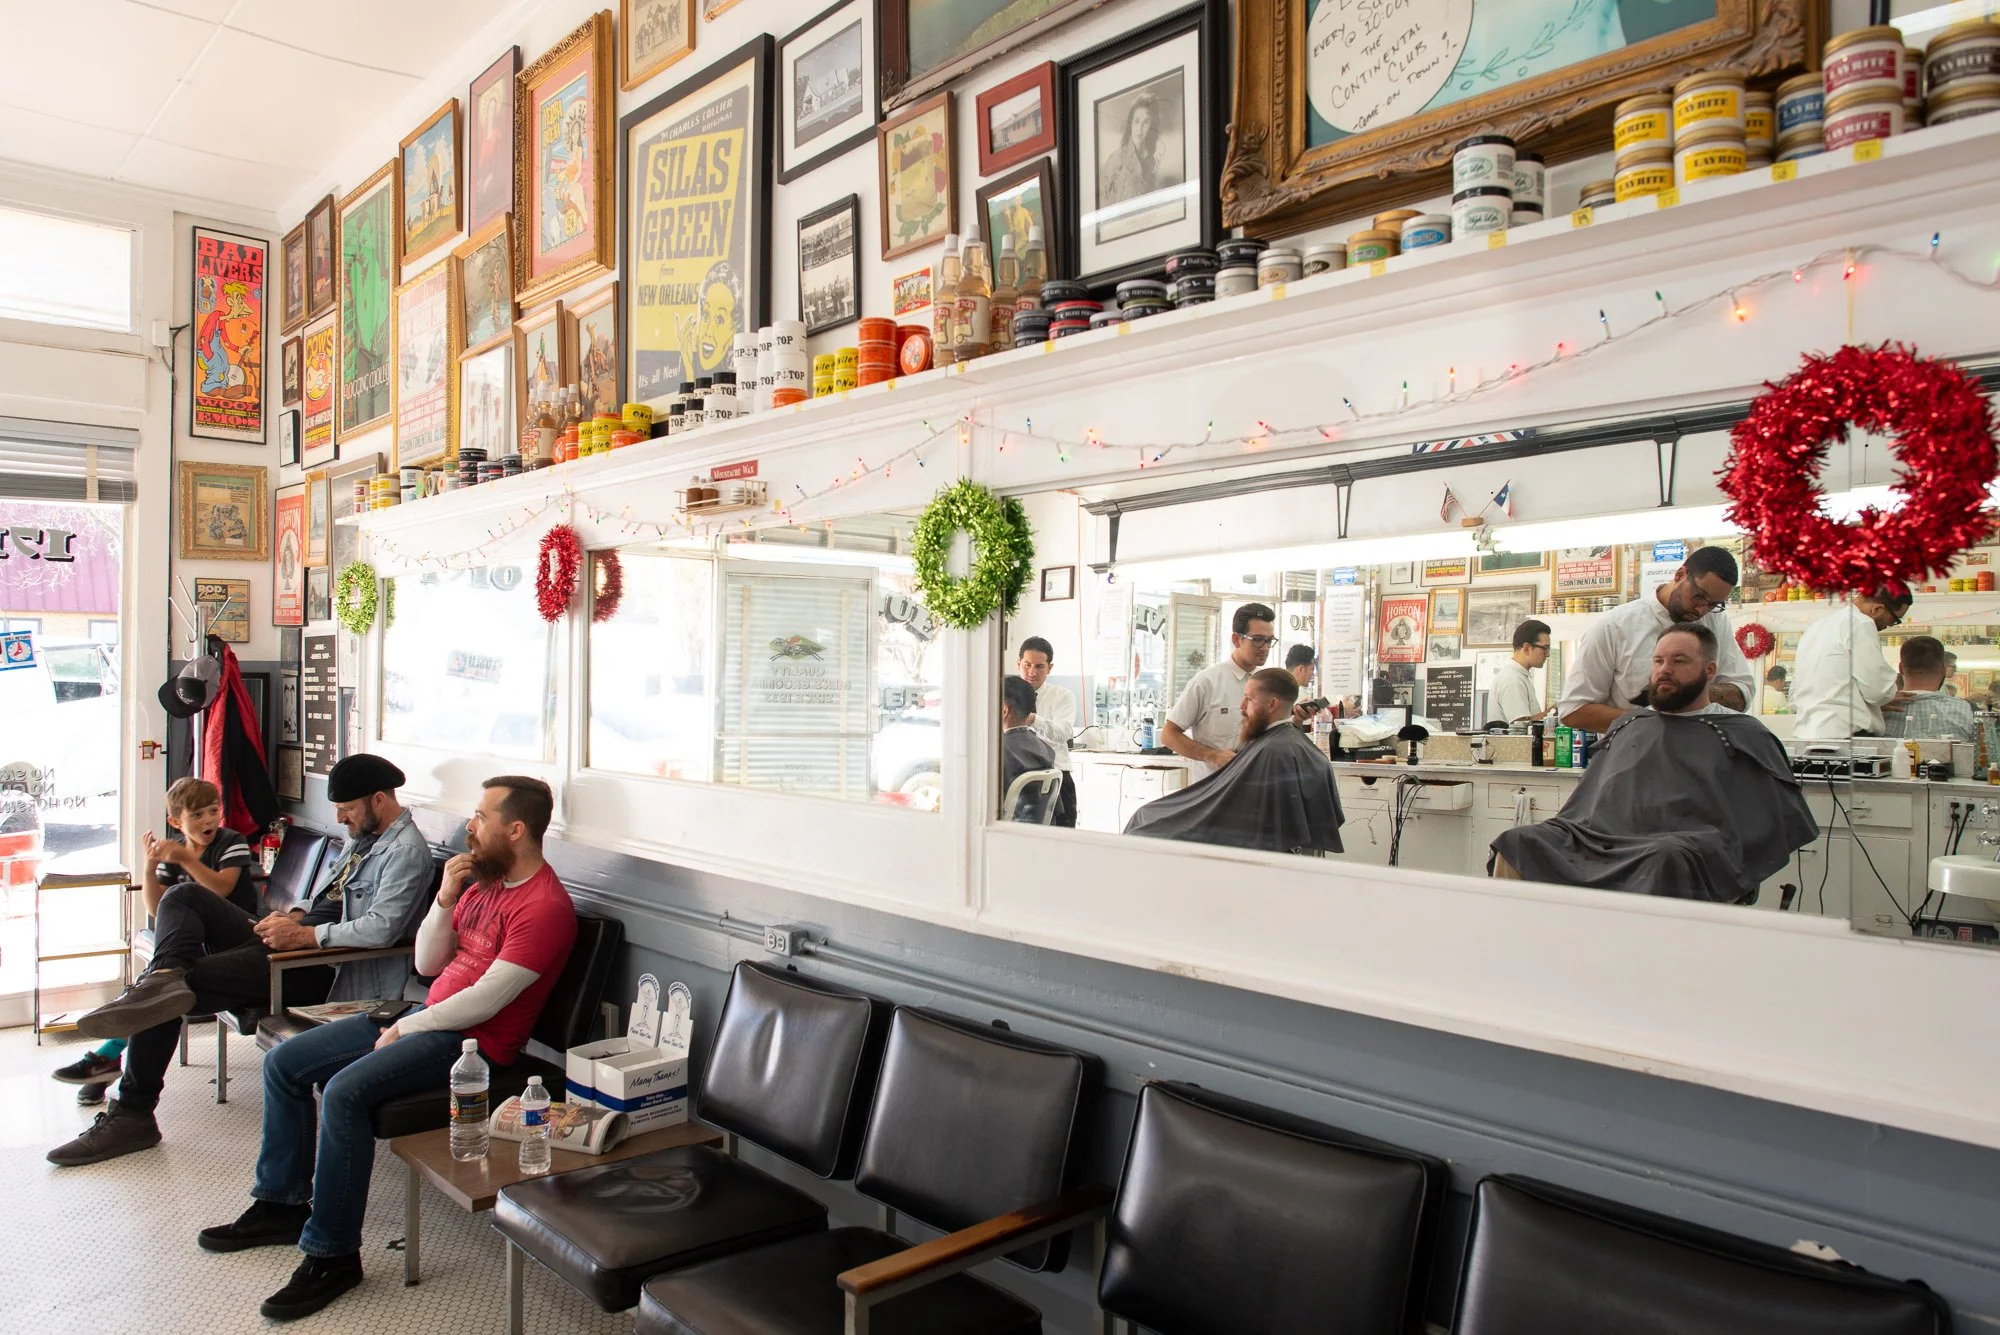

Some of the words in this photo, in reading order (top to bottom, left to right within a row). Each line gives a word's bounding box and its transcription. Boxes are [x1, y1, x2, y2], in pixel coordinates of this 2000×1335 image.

[1361, 33, 1383, 56] THE
[1331, 23, 1422, 109] CONTINENTAL
[1388, 41, 1427, 83] CLUB
[669, 115, 700, 140] CHARLES
[702, 98, 733, 121] COLLIER
[702, 113, 732, 132] ORIGINAL
[650, 138, 732, 202] SILAS
[643, 199, 732, 261] GREEN
[200, 237, 262, 266] BAD
[198, 255, 262, 283] LIVERS
[637, 285, 657, 306] NEW
[659, 283, 699, 306] ORLEANS
[306, 327, 333, 367] COWS
[777, 336, 793, 345] TOP
[651, 367, 661, 382] all
[789, 370, 805, 380] TOP
[741, 381, 757, 390] TOP
[197, 397, 259, 412] WOOL
[715, 409, 732, 419] TOP
[197, 412, 260, 428] EMO'S
[671, 418, 684, 427] TOP
[198, 585, 222, 593] ROD
[1563, 578, 1598, 586] CONTINENTAL
[1599, 576, 1613, 584] CLUB
[1387, 605, 1420, 624] HORTON
[629, 1077, 652, 1089] Many
[652, 1068, 681, 1083] Thanks!
